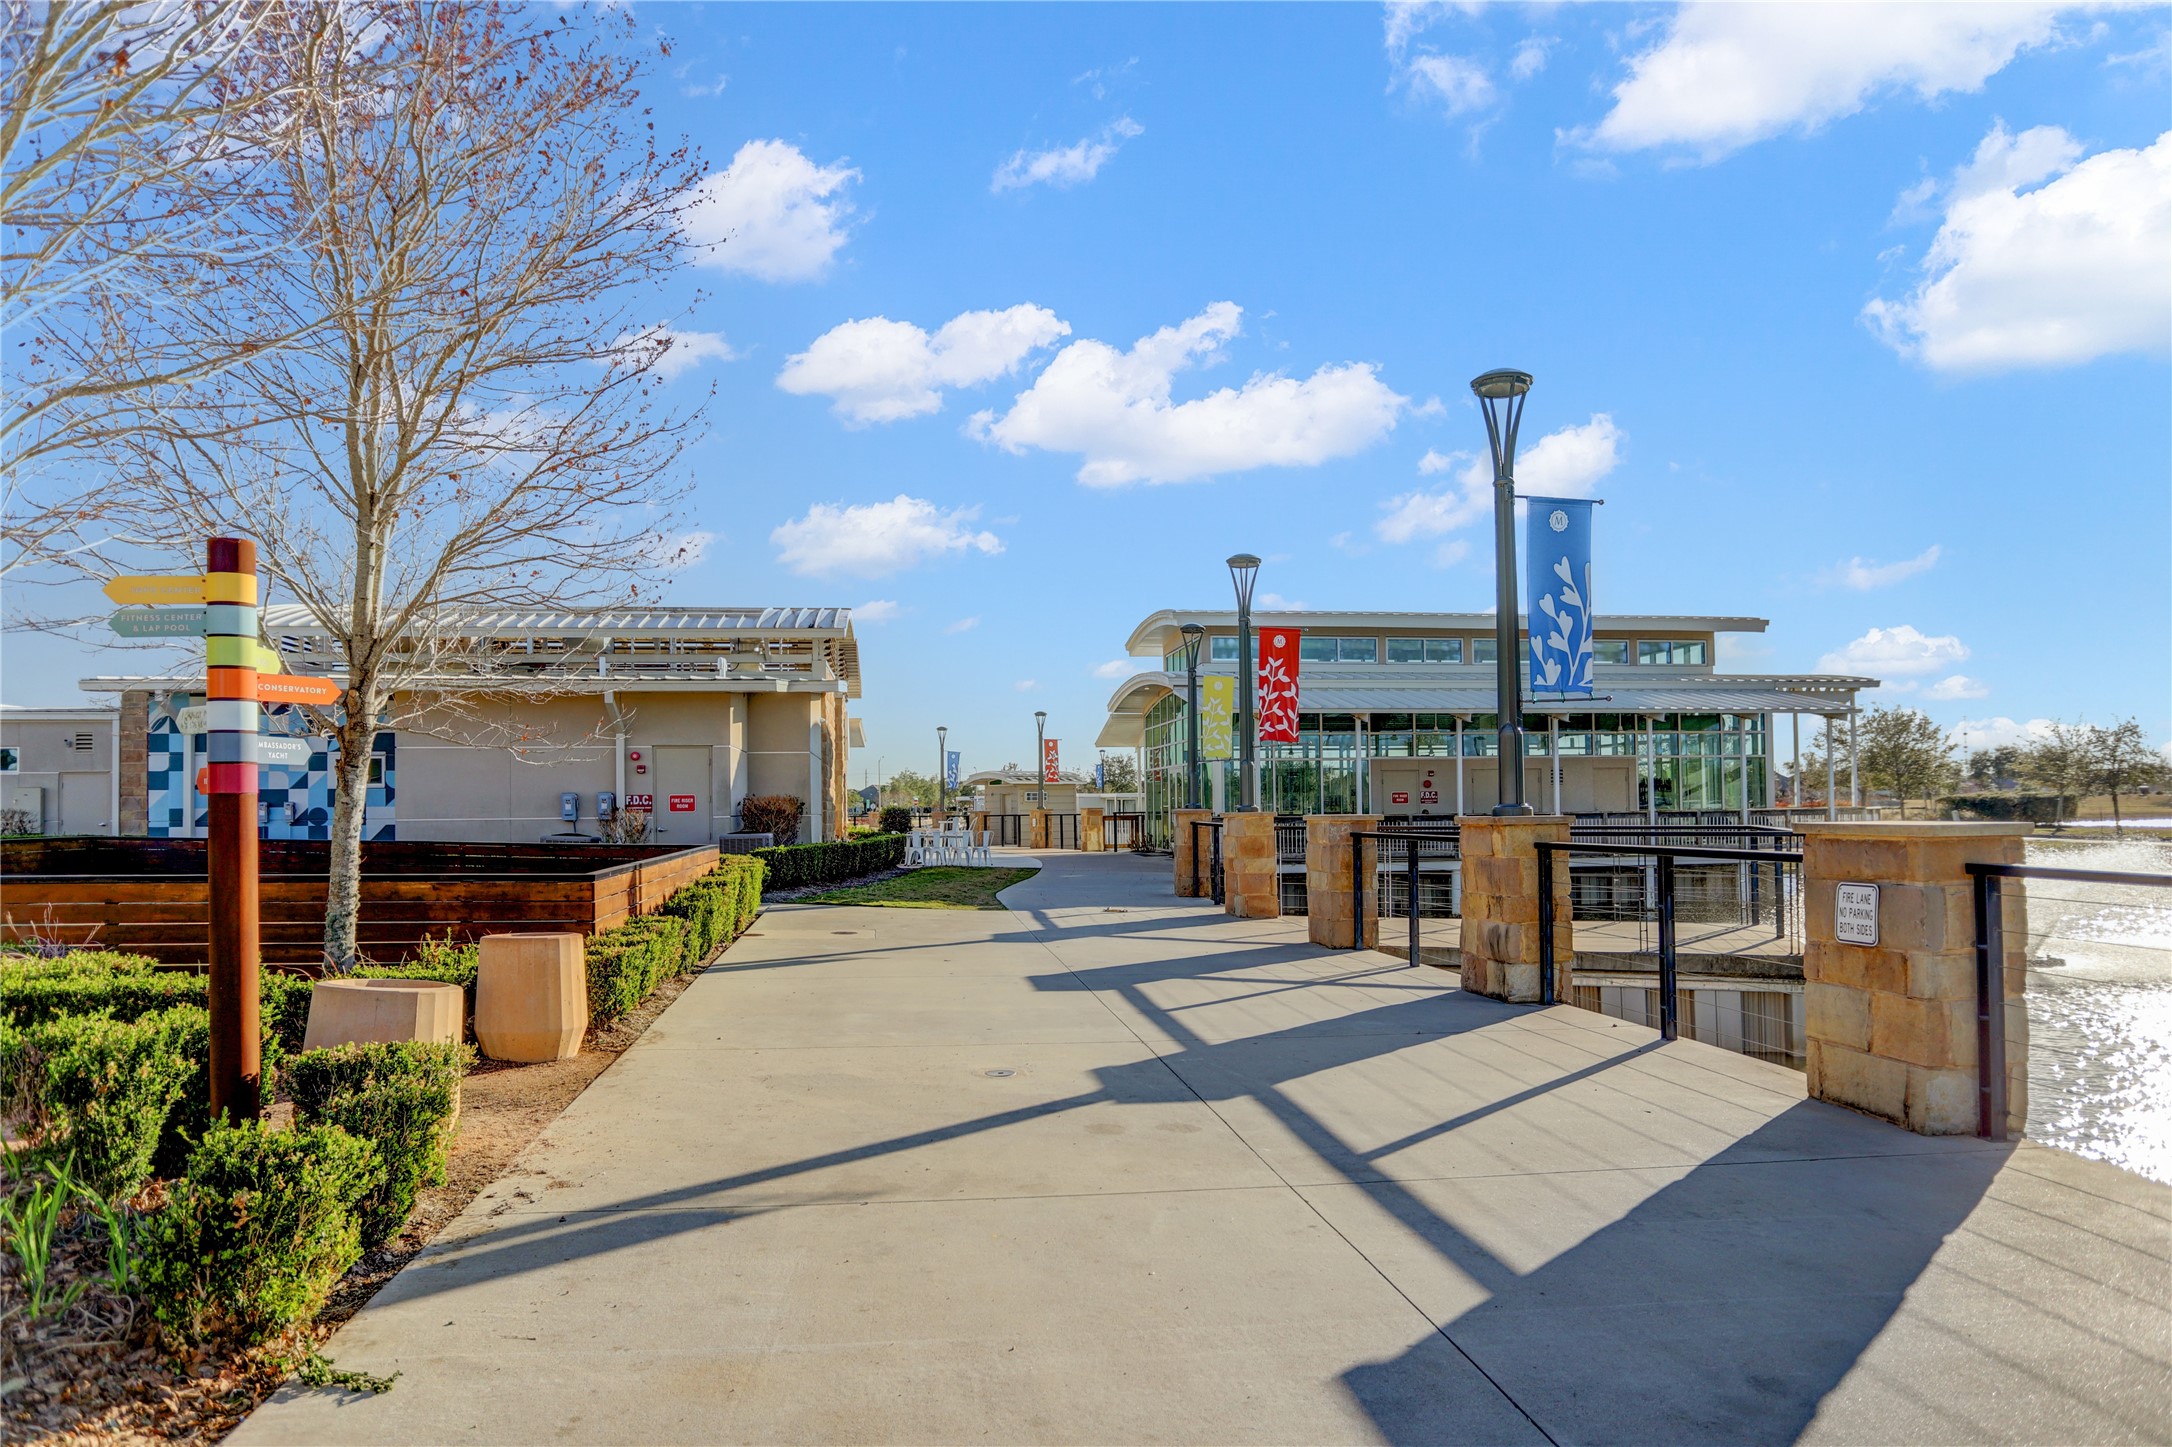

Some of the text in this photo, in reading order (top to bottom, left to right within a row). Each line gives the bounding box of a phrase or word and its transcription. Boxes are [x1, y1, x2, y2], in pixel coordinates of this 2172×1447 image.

[160, 586, 202, 594] CENTER
[121, 613, 202, 622] FITNESS CENTER
[133, 624, 191, 632] & LAP POOL
[257, 683, 327, 695] CONSERVATORY
[257, 741, 302, 750] MBASSADOR'S
[267, 751, 288, 760] YACHT
[1420, 791, 1438, 799] F.D.C.
[625, 795, 652, 805] F.D.C.
[1842, 891, 1871, 905] FIRE LANE
[1839, 907, 1873, 921] NO PARKING
[1839, 922, 1873, 937] BOTH SIDES
